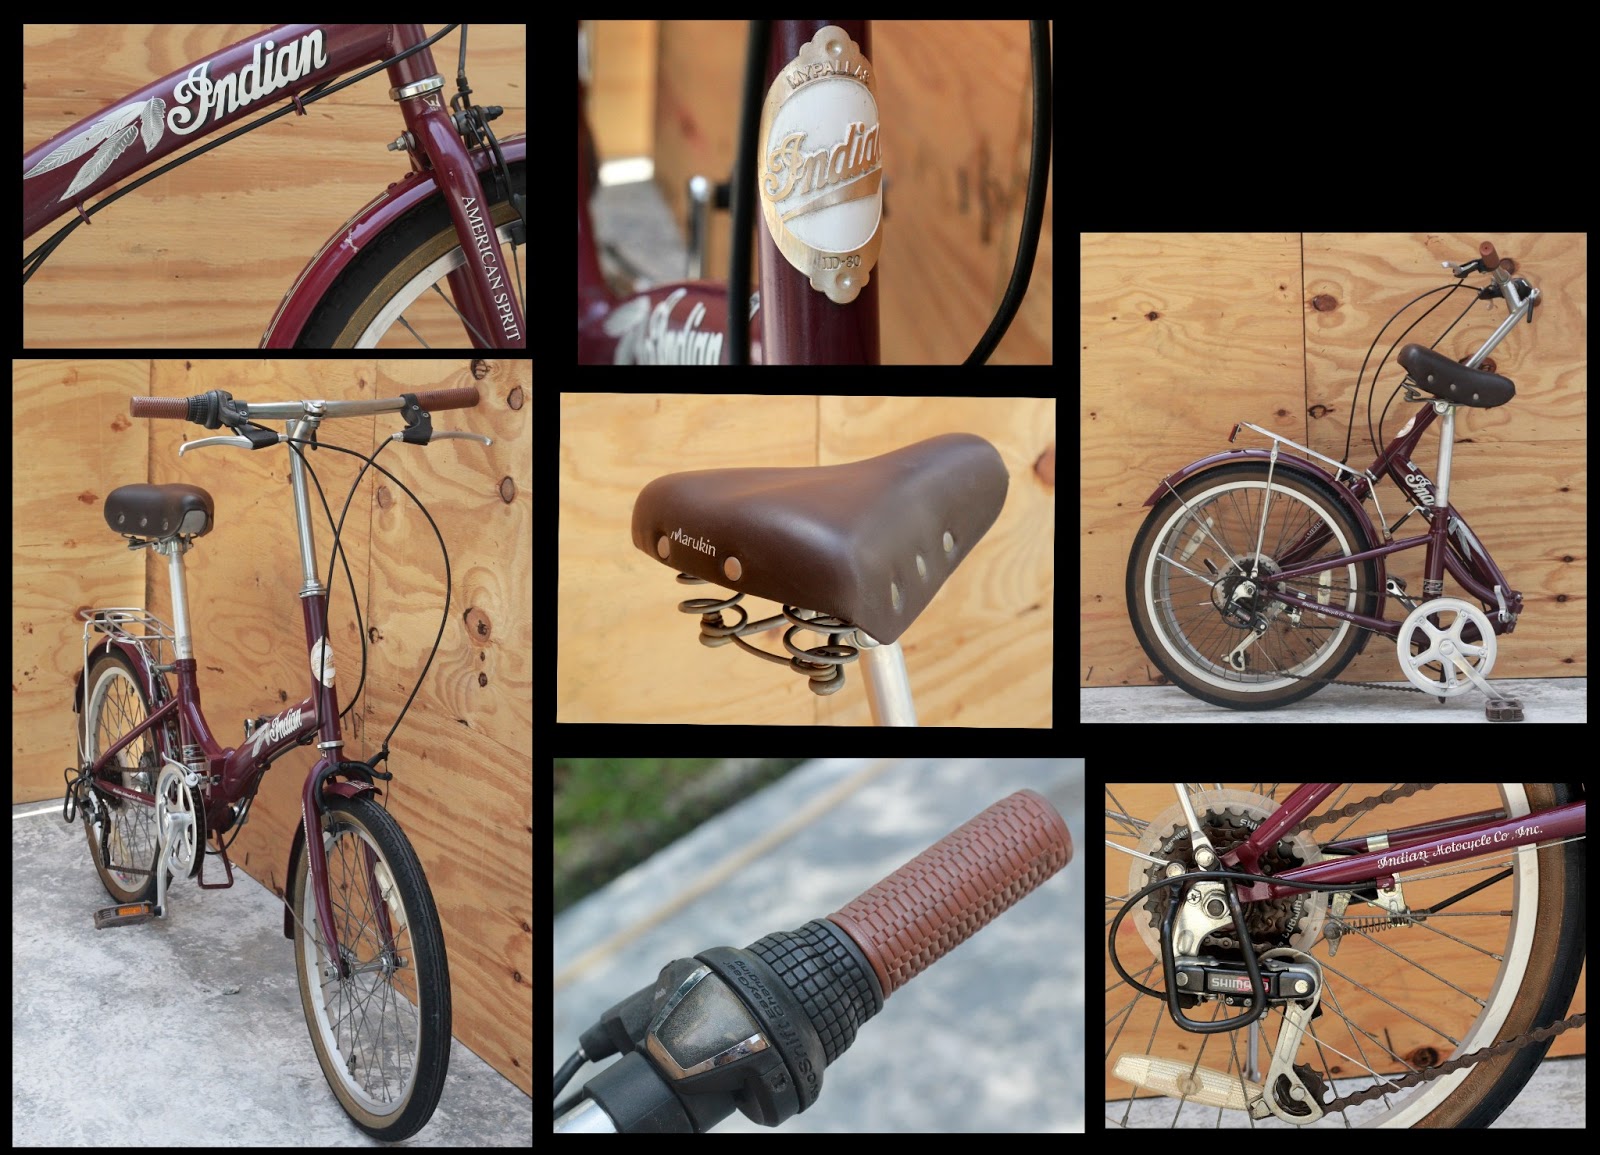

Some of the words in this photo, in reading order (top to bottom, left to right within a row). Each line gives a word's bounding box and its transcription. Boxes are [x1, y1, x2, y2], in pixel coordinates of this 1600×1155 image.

[167, 29, 327, 135] Indian
[461, 196, 504, 289] AMERICAN
[494, 293, 521, 341] SPRIT
[670, 527, 716, 557] Marukin
[269, 707, 303, 742] Indian
[1377, 849, 1429, 870] Indian
[733, 960, 785, 1018] Changing
